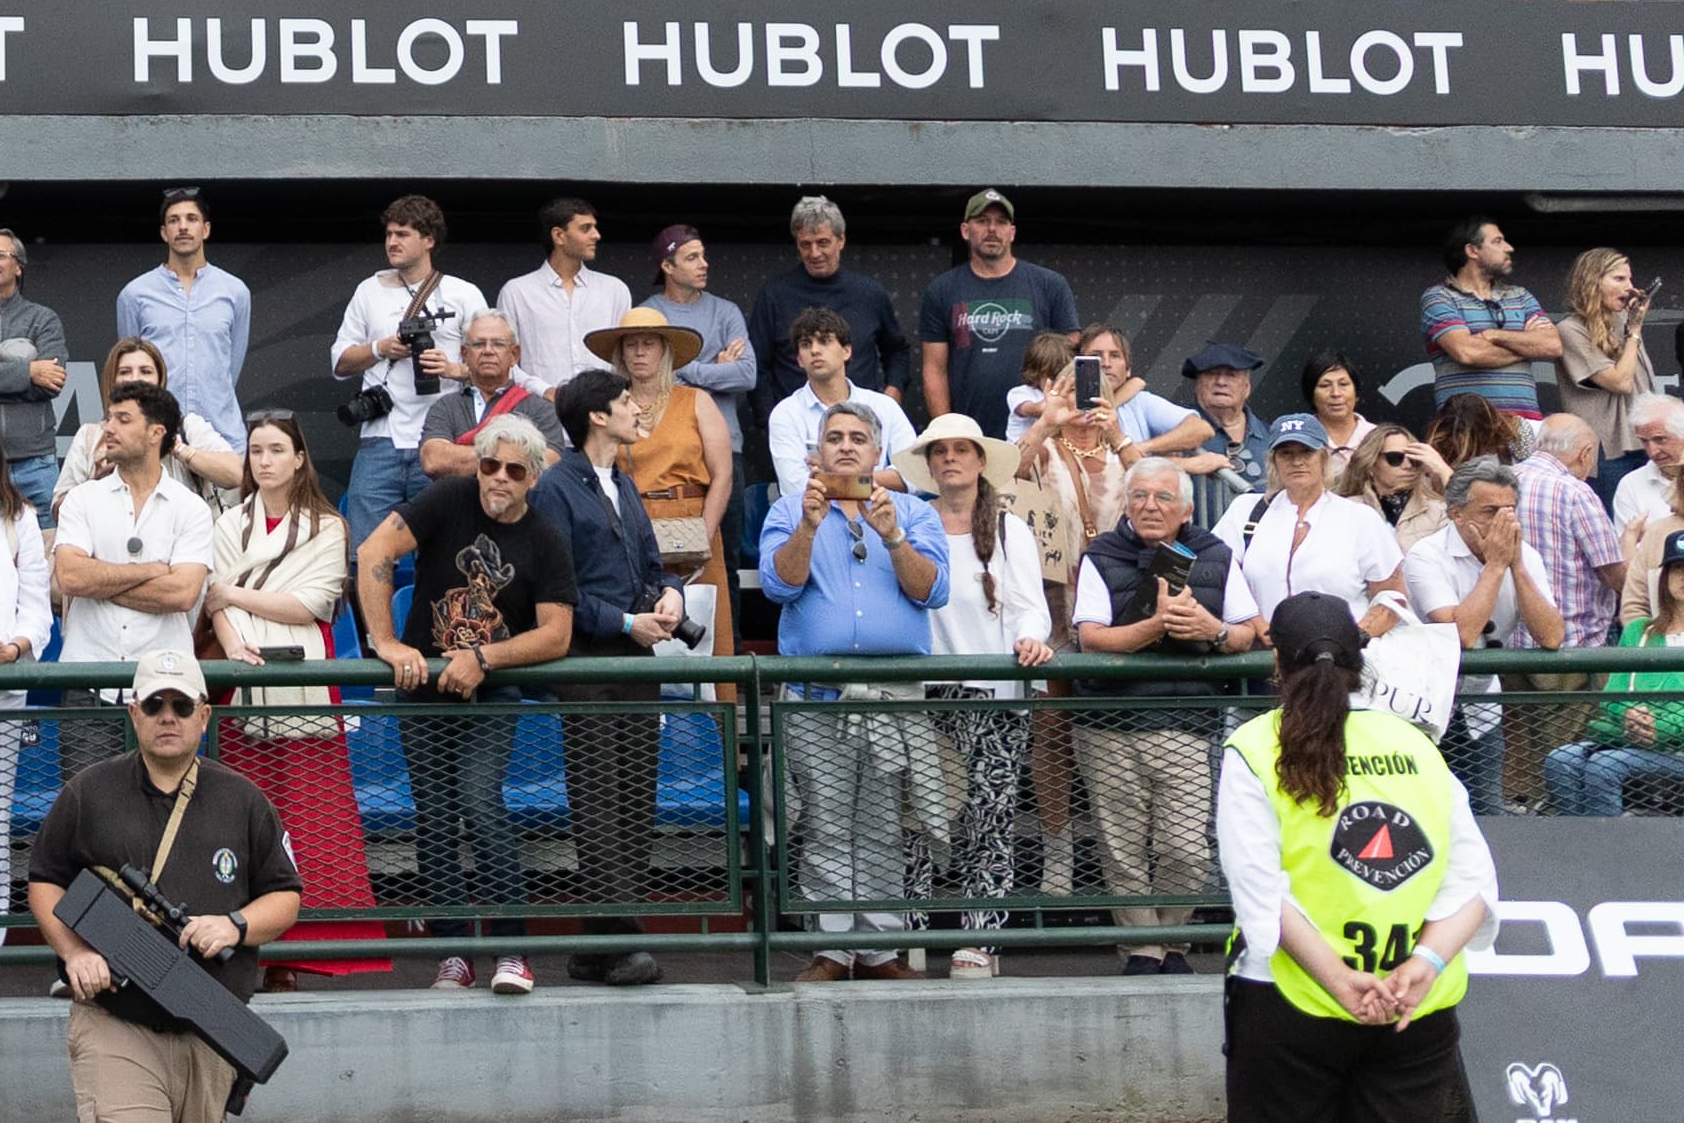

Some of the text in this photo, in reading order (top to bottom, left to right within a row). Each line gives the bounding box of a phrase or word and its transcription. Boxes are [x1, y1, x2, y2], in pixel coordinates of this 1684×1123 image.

[134, 18, 517, 85] HUBLOT
[624, 21, 999, 88] HUBLOT
[1103, 27, 1463, 95] HUBLOT
[1562, 34, 1684, 98] HU
[958, 309, 1022, 327] Hard Rock
[1280, 420, 1305, 432] NY
[1340, 805, 1411, 832] ROAD
[1338, 846, 1430, 884] PREVENCIÓN
[1343, 921, 1424, 975] 34
